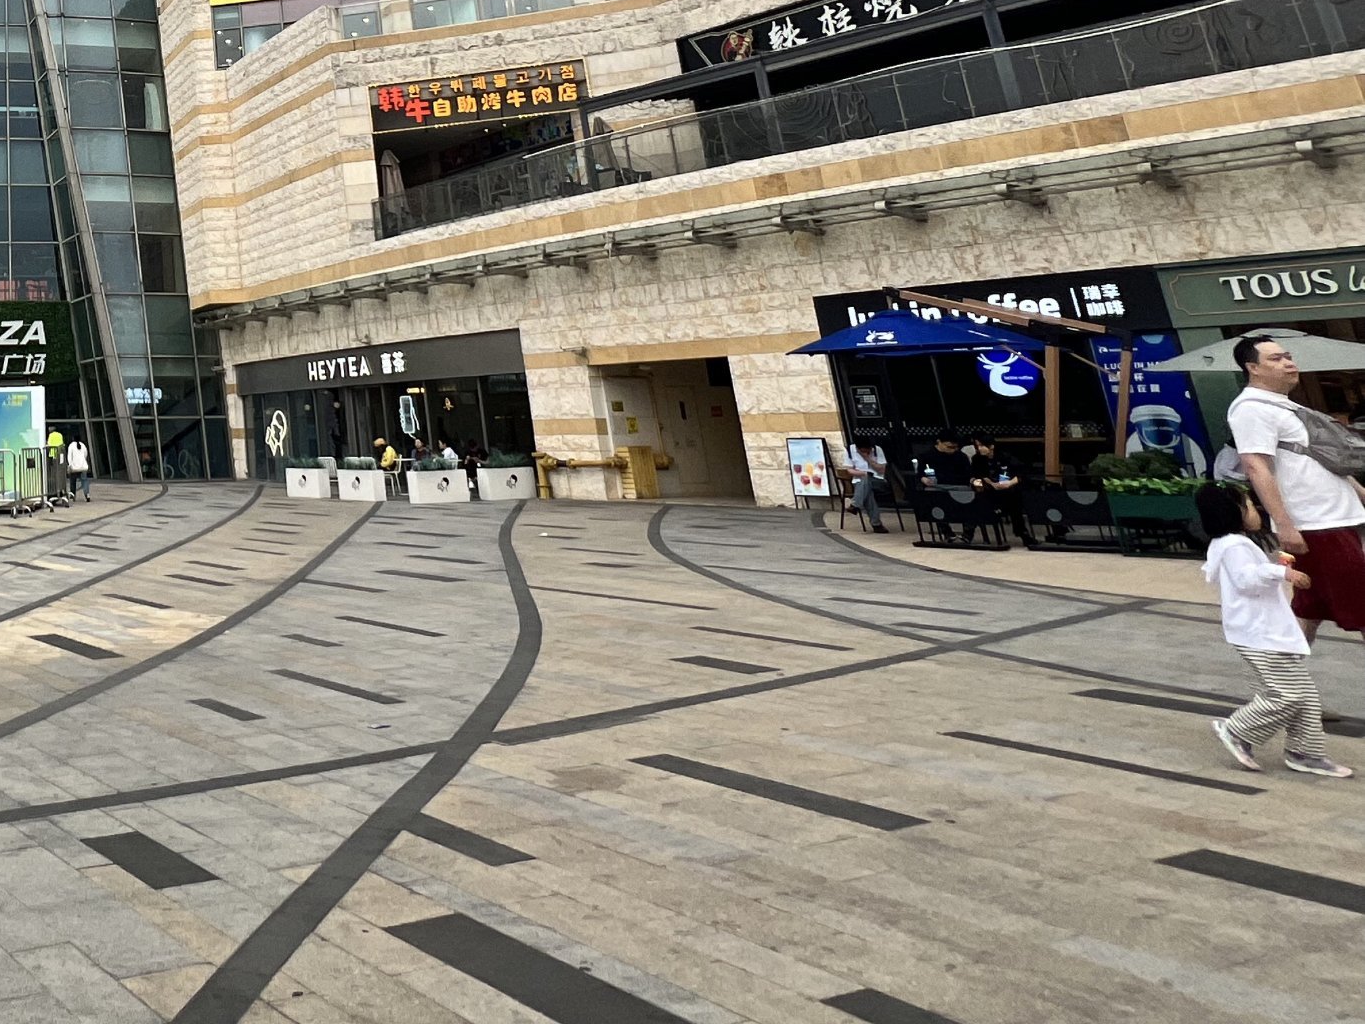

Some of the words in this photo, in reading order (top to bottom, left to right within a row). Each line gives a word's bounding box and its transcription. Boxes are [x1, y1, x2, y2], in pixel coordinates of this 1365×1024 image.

[1081, 283, 1121, 301] 瑞幸
[1219, 268, 1339, 301] TOUS
[1085, 299, 1126, 316] 咖啡
[308, 355, 371, 381] HEYTEA
[380, 351, 405, 374] 喜茶
